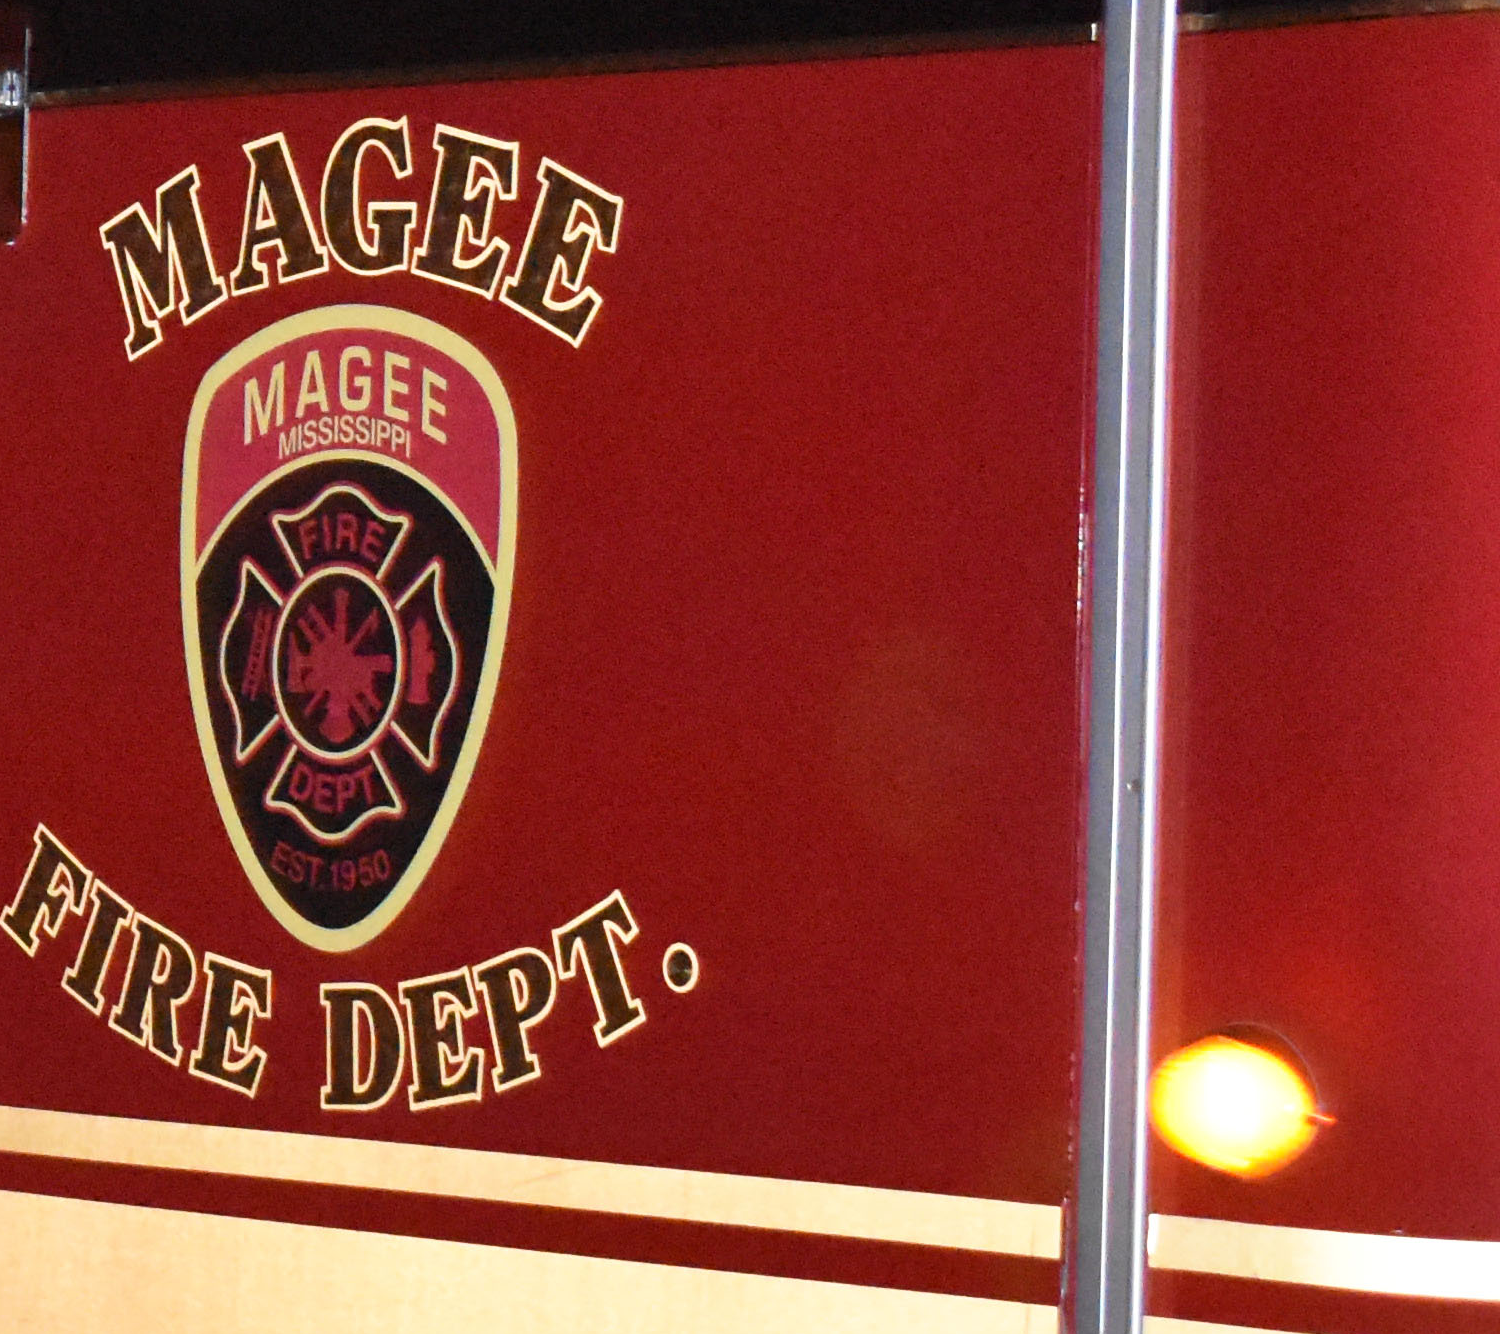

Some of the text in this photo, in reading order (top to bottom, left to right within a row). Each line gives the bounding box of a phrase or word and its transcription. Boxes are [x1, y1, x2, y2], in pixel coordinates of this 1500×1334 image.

[99, 116, 623, 360] MAGEE
[244, 345, 448, 446] MAGEE
[278, 415, 411, 460] MISSISSIPPI
[299, 512, 386, 563] FIRE
[288, 763, 375, 814] DEPT
[0, 824, 699, 1112] FIRE DEPT.
